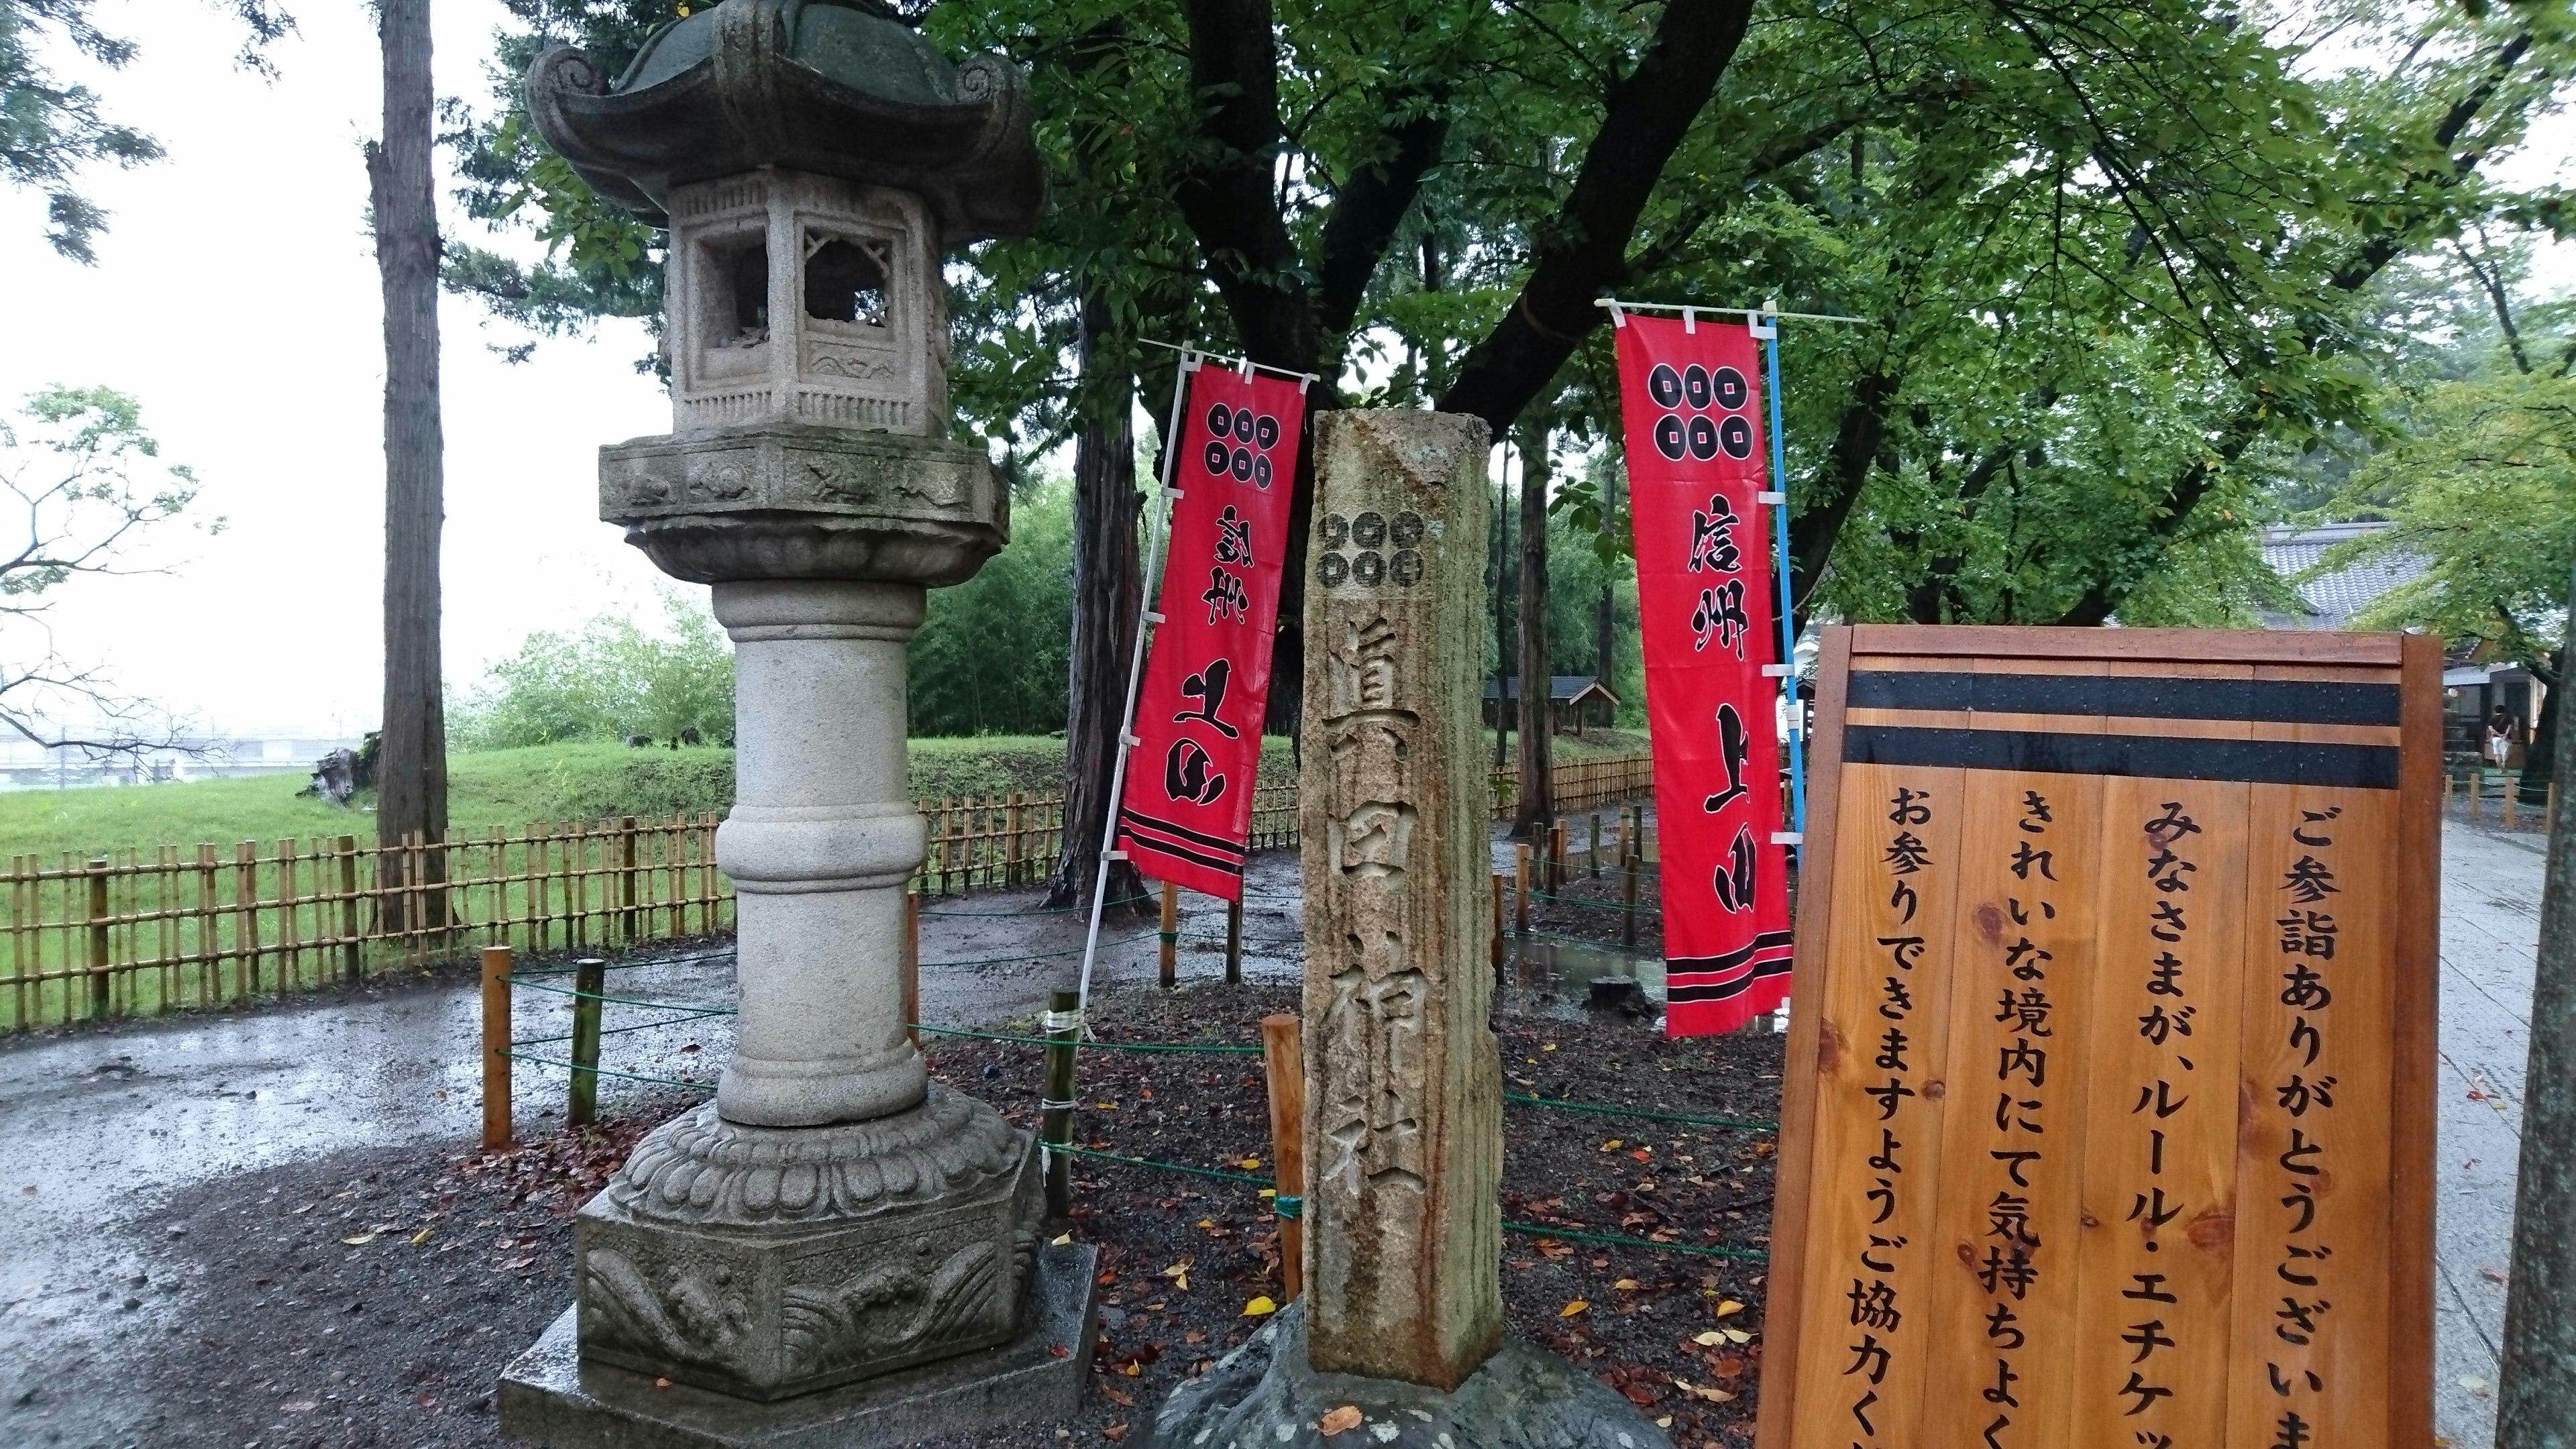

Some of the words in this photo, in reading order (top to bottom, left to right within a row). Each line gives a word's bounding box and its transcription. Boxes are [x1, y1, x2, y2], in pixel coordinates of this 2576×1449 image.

[1842, 787, 1935, 1449] お参りできますようご協力く
